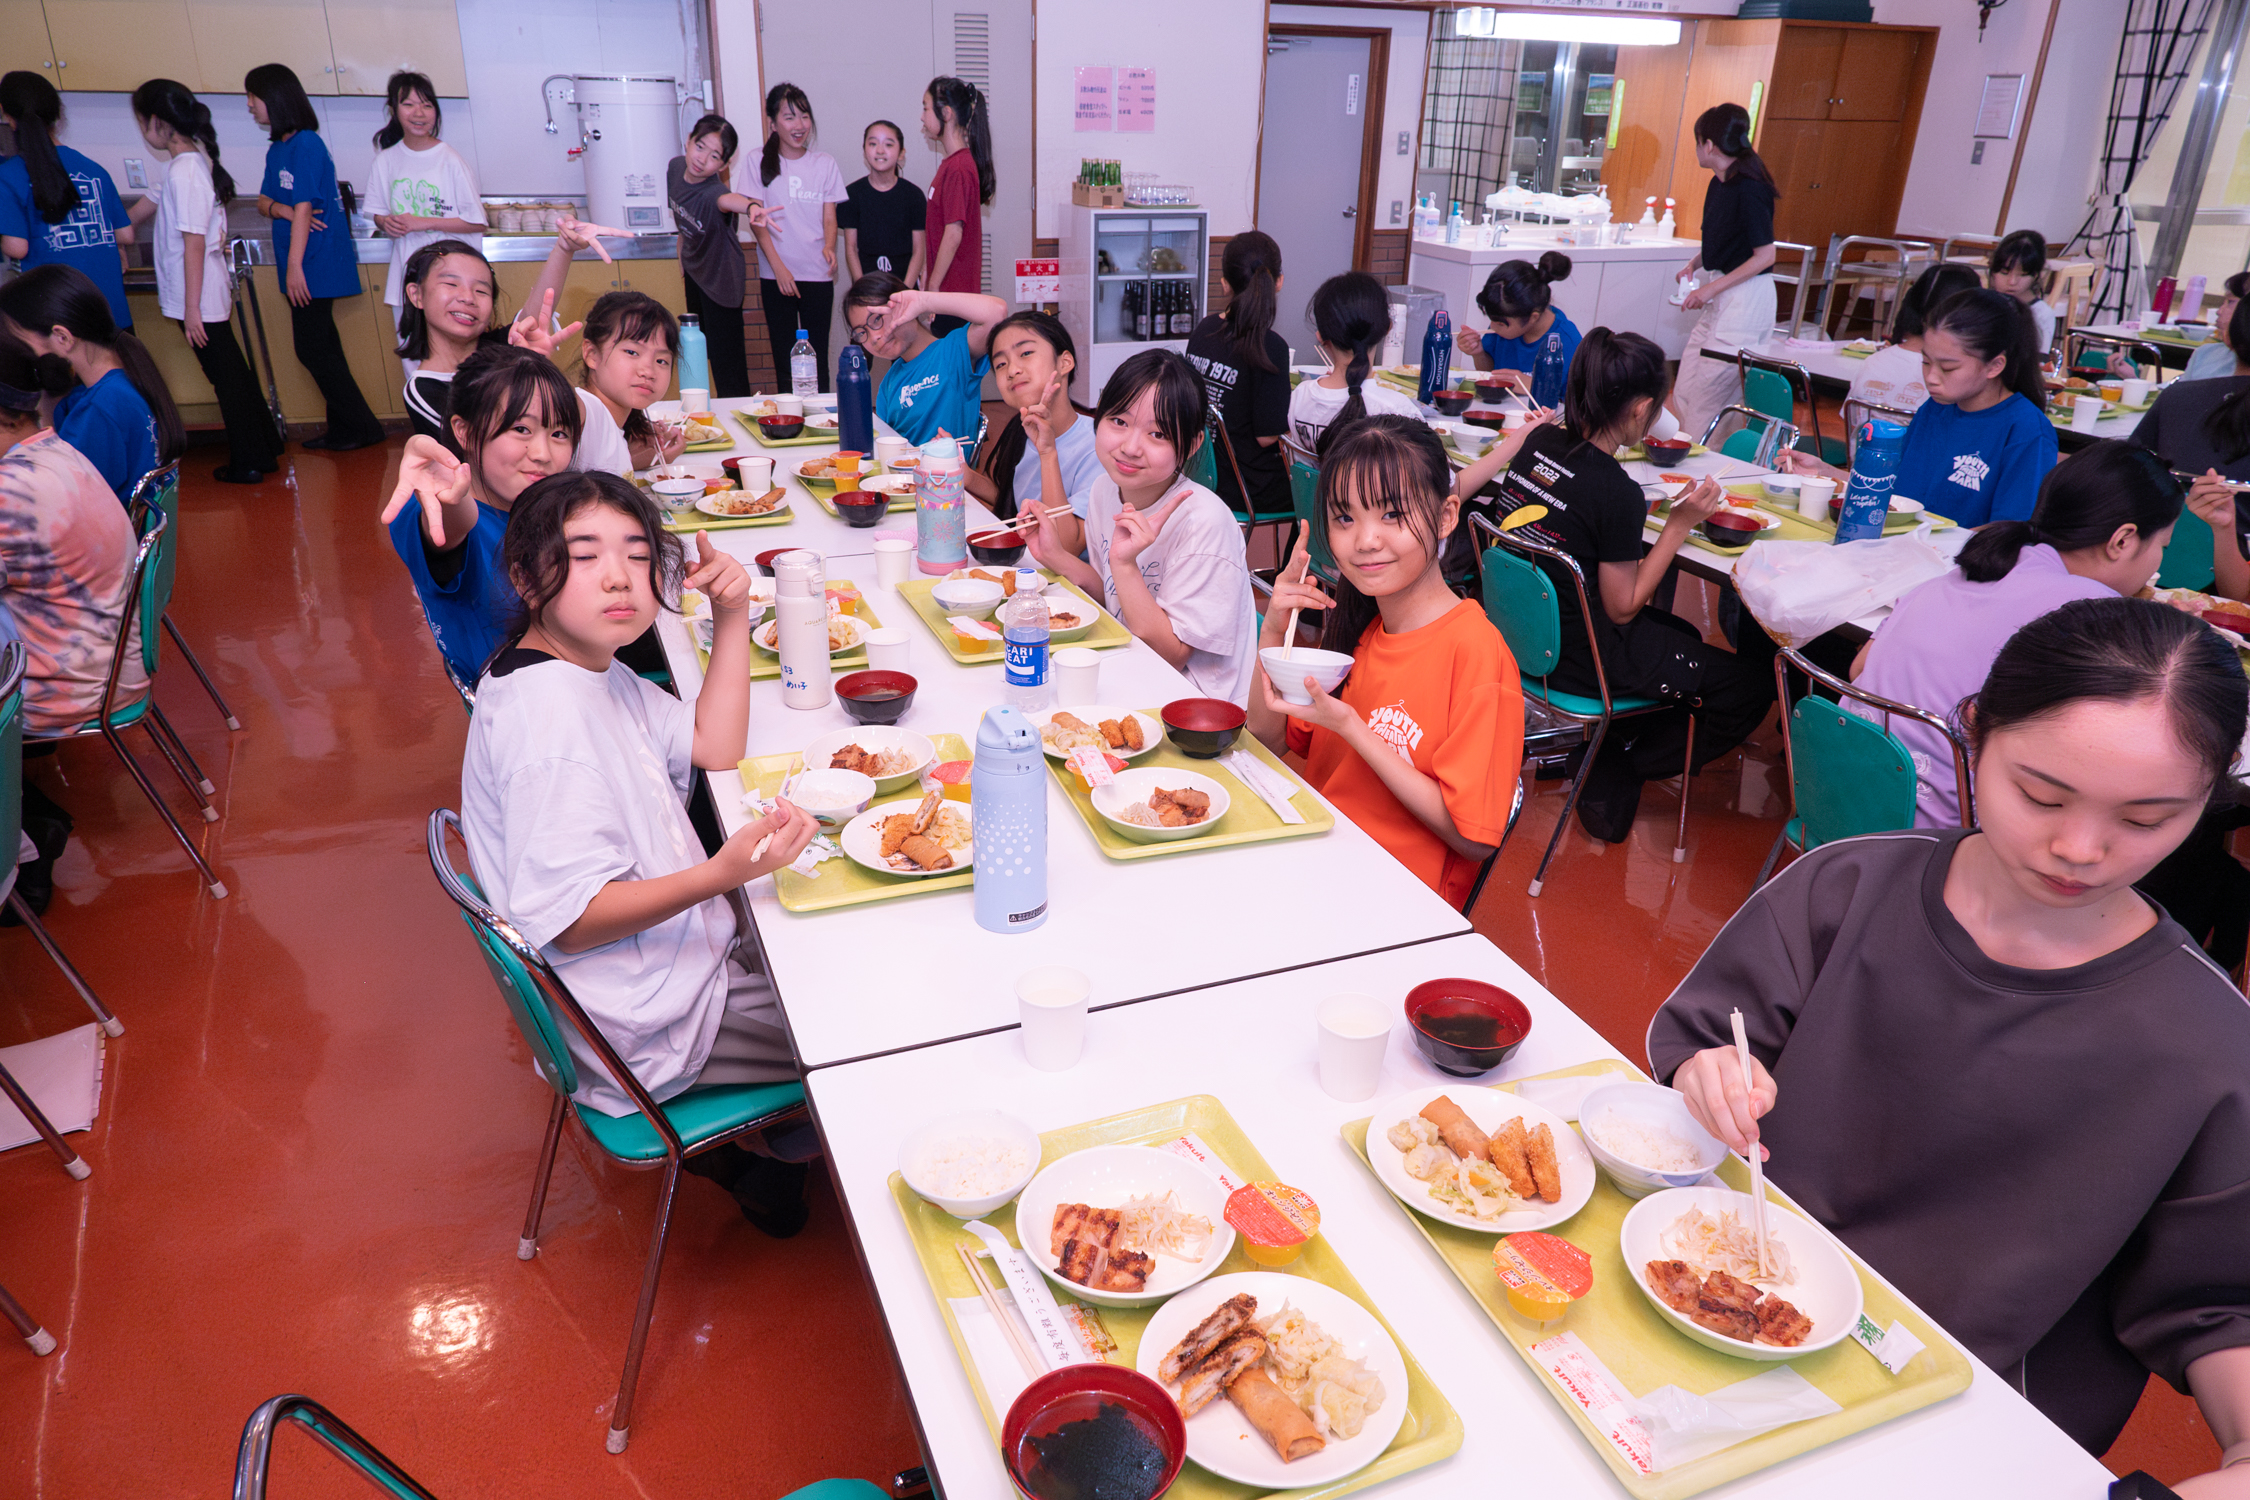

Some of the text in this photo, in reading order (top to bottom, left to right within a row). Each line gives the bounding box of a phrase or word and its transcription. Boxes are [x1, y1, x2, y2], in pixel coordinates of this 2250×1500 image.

[1209, 361, 1238, 385] 1978
[1436, 350, 1444, 385] HYDRATION
[1534, 463, 1560, 483] 2022
[1953, 455, 1990, 480] YOUTH
[1532, 486, 1541, 494] OF
[1542, 492, 1556, 504] NEW
[1553, 499, 1567, 511] ERA
[1006, 644, 1033, 656] CARI
[1368, 707, 1424, 751] YOUTH
[1373, 723, 1408, 746] THEATRE
[1179, 1136, 1206, 1163] Yakult
[1218, 1174, 1235, 1192] Yak
[1266, 1189, 1308, 1228] オレンジゼリー
[1506, 1248, 1556, 1292] オレンジゼリー
[1008, 1258, 1070, 1362] 毎度有難うございます
[1553, 1365, 1591, 1408] Yakult
[1612, 1431, 1652, 1474] Yakult
